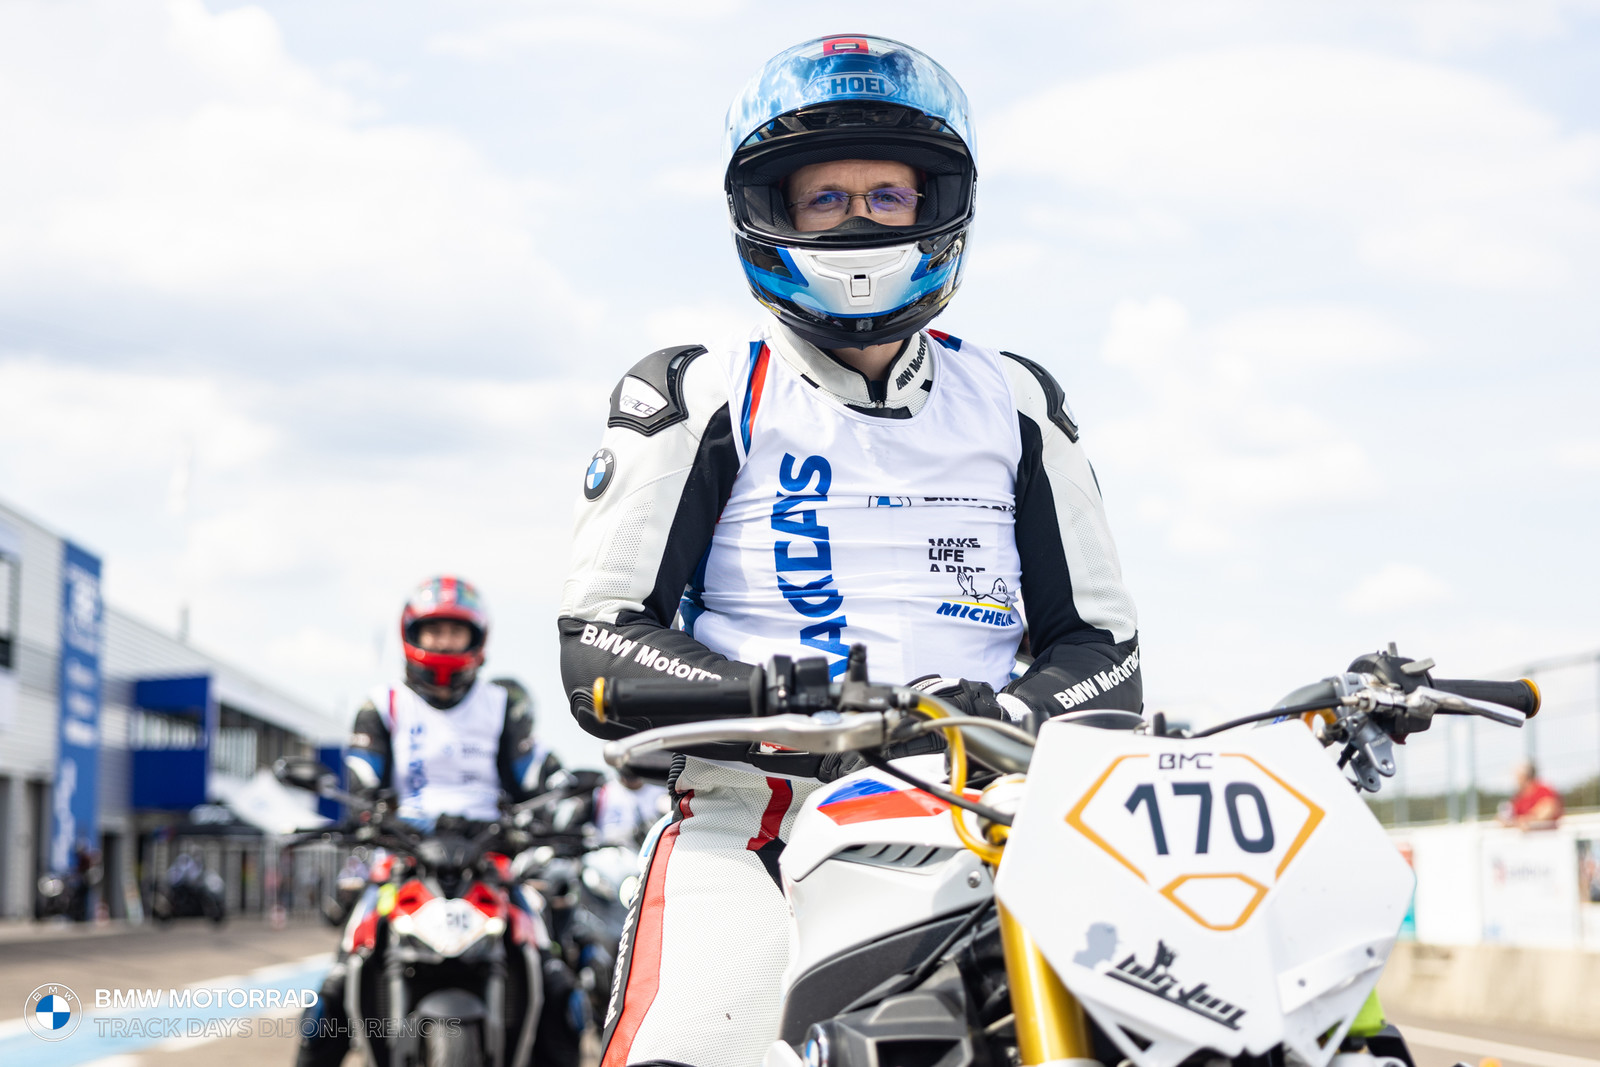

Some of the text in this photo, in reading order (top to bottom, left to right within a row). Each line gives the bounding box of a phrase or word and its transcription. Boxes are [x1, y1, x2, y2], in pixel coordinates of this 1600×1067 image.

[928, 548, 964, 562] LIFE
[930, 563, 941, 573] A
[580, 623, 638, 658] BMW
[1053, 678, 1100, 710] BMW
[1158, 752, 1213, 770] BMC
[1124, 781, 1275, 856] 170
